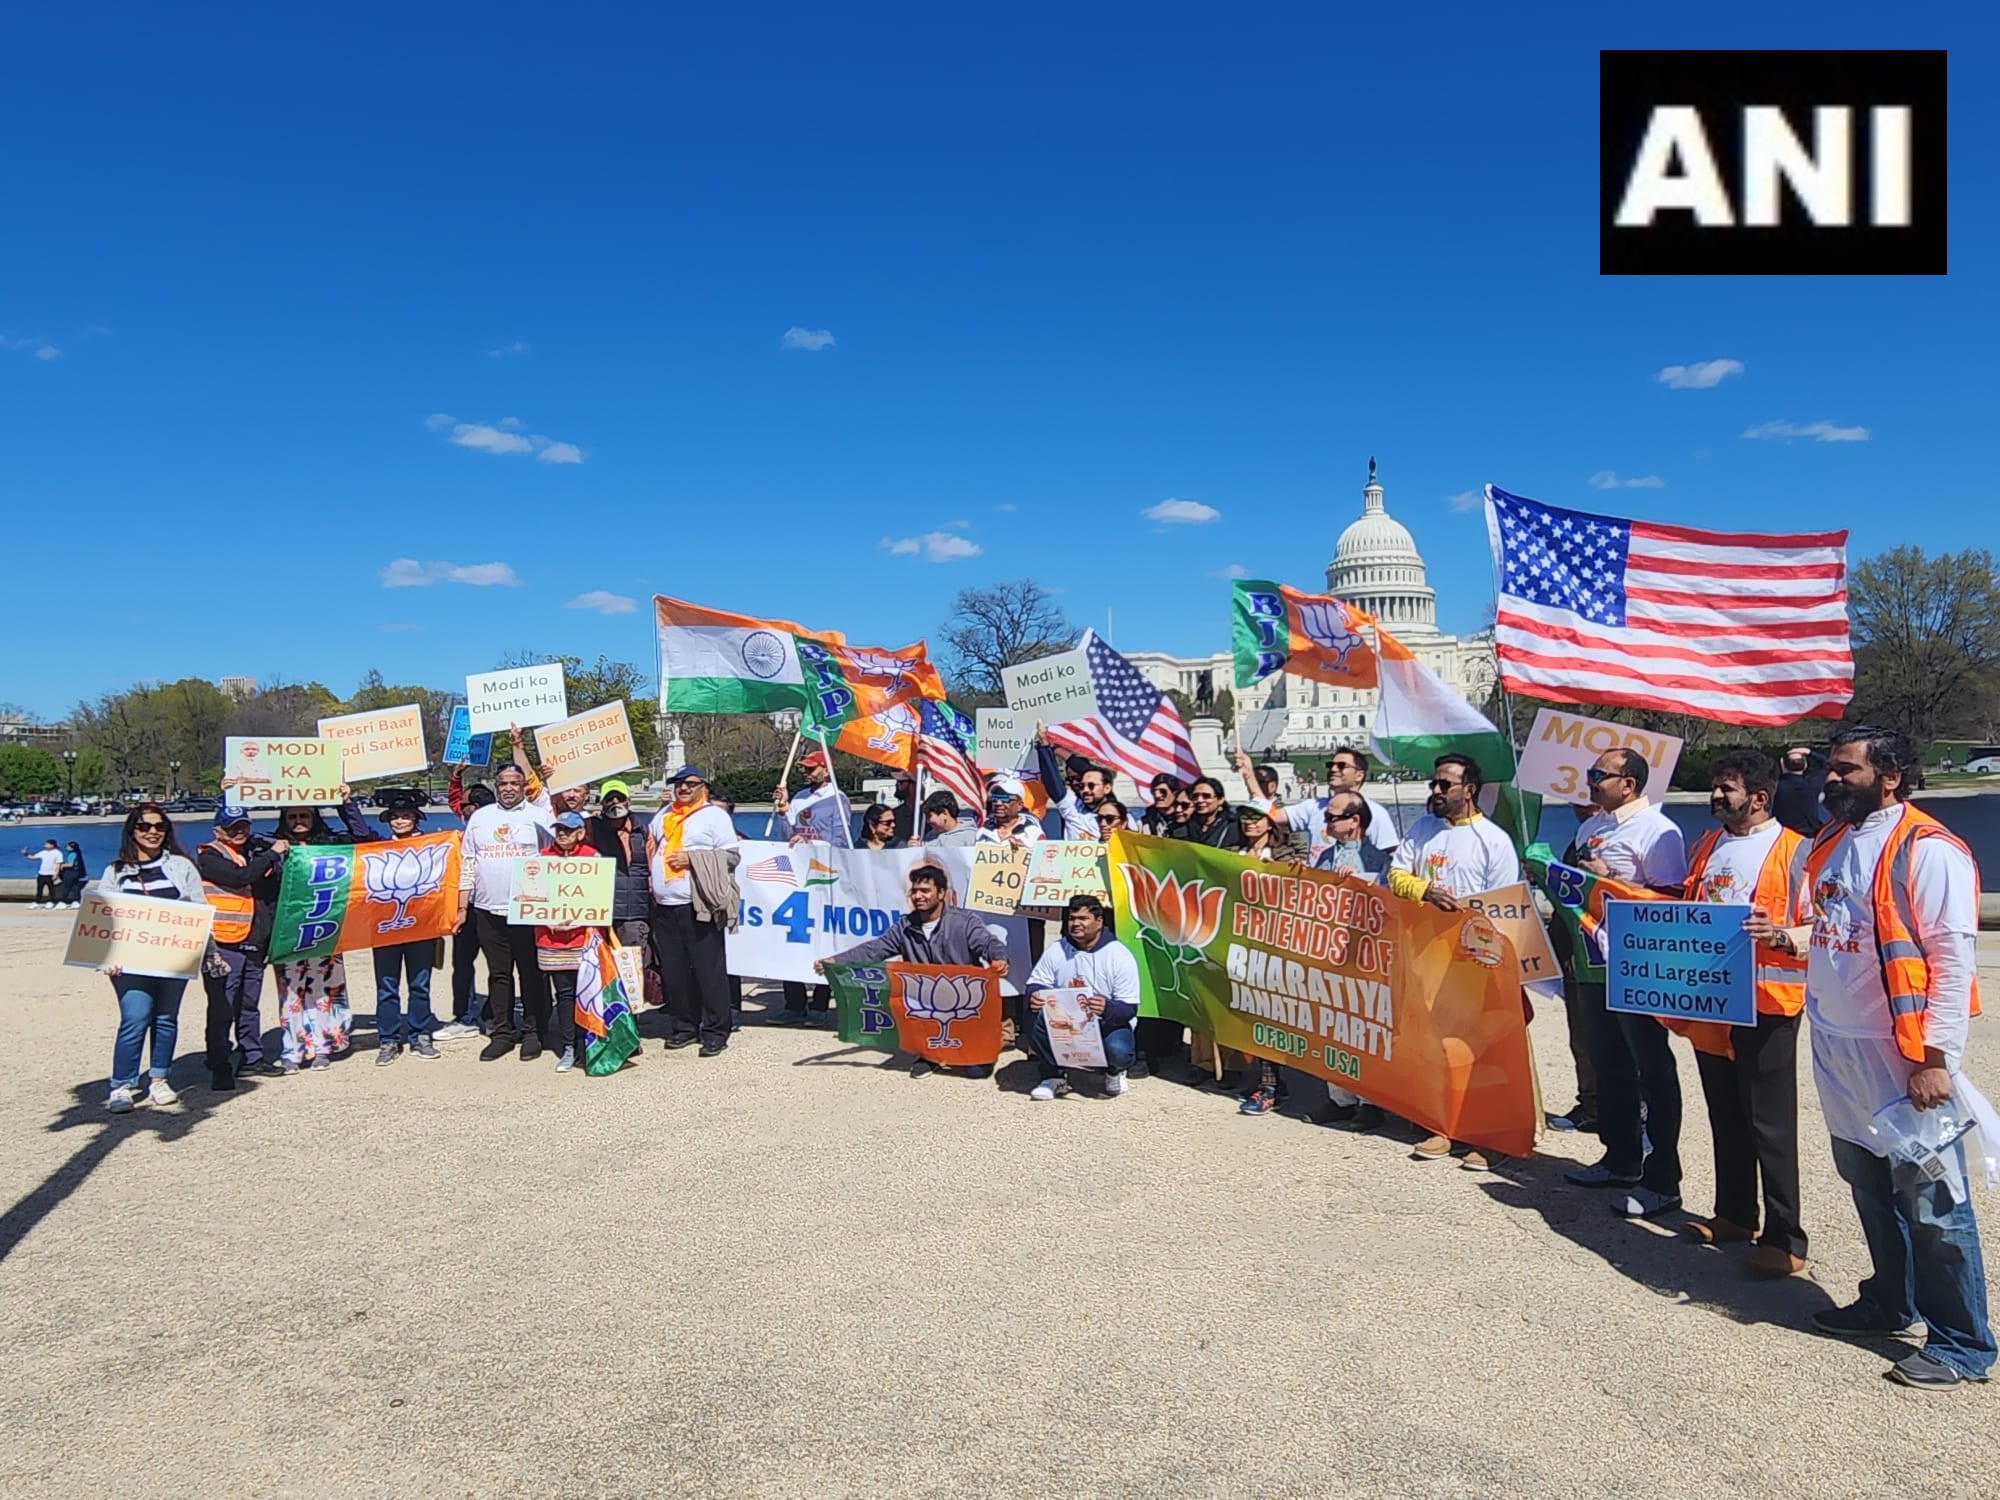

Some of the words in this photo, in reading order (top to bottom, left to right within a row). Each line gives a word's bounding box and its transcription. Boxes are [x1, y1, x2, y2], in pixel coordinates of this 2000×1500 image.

[1245, 592, 1287, 679] BJP
[483, 677, 524, 694] Modi
[530, 676, 548, 687] ko
[1017, 668, 1053, 688] Modi
[1057, 665, 1075, 678] ko
[473, 698, 530, 714] chunte
[536, 691, 563, 705] Hai
[1011, 691, 1061, 711] chunte
[1066, 681, 1091, 698] Hai
[326, 722, 373, 738] Teesri
[379, 718, 414, 731] Baar
[543, 724, 583, 747] Teesri
[588, 713, 620, 732] Baar
[988, 718, 1013, 729] Mod
[267, 743, 325, 756] MODI
[342, 743, 365, 757] odi
[370, 735, 420, 752] Sarkar
[545, 746, 580, 768] Modi
[583, 733, 628, 755] Sarkar
[979, 737, 1020, 749] chunte
[1541, 716, 1668, 768] MODI
[281, 766, 311, 778] KA
[1550, 766, 1588, 799] 3.
[240, 784, 341, 800] Parivar
[975, 850, 1014, 864] Abki
[1064, 845, 1107, 857] MOD
[547, 862, 598, 875] MODI
[1071, 867, 1096, 879] KA
[558, 885, 584, 897] KA
[89, 901, 152, 920] Teesri
[158, 910, 204, 927] Baar
[294, 855, 347, 952] BJP
[520, 904, 609, 921] Parivar
[1241, 870, 1384, 936] OVERSEAS
[1469, 899, 1530, 920] Baar
[772, 891, 815, 944] 4
[1634, 906, 1679, 923] Modi
[1686, 908, 1712, 925] Ka
[78, 924, 132, 941] Modi
[136, 931, 203, 950] Sarkar
[1233, 902, 1350, 966] FRIENDS
[1356, 935, 1393, 976] OF
[1623, 933, 1726, 954] Guarantee
[1620, 960, 1649, 977] 3rd
[1655, 963, 1732, 987] Largest
[1227, 943, 1393, 1028] BHARATIYA
[1624, 988, 1728, 1015] ECONOMY
[1230, 981, 1314, 1033] JANATA
[1319, 1006, 1393, 1061] PARTY
[1253, 1022, 1307, 1057] OFBJP
[1325, 1046, 1360, 1081] USA
